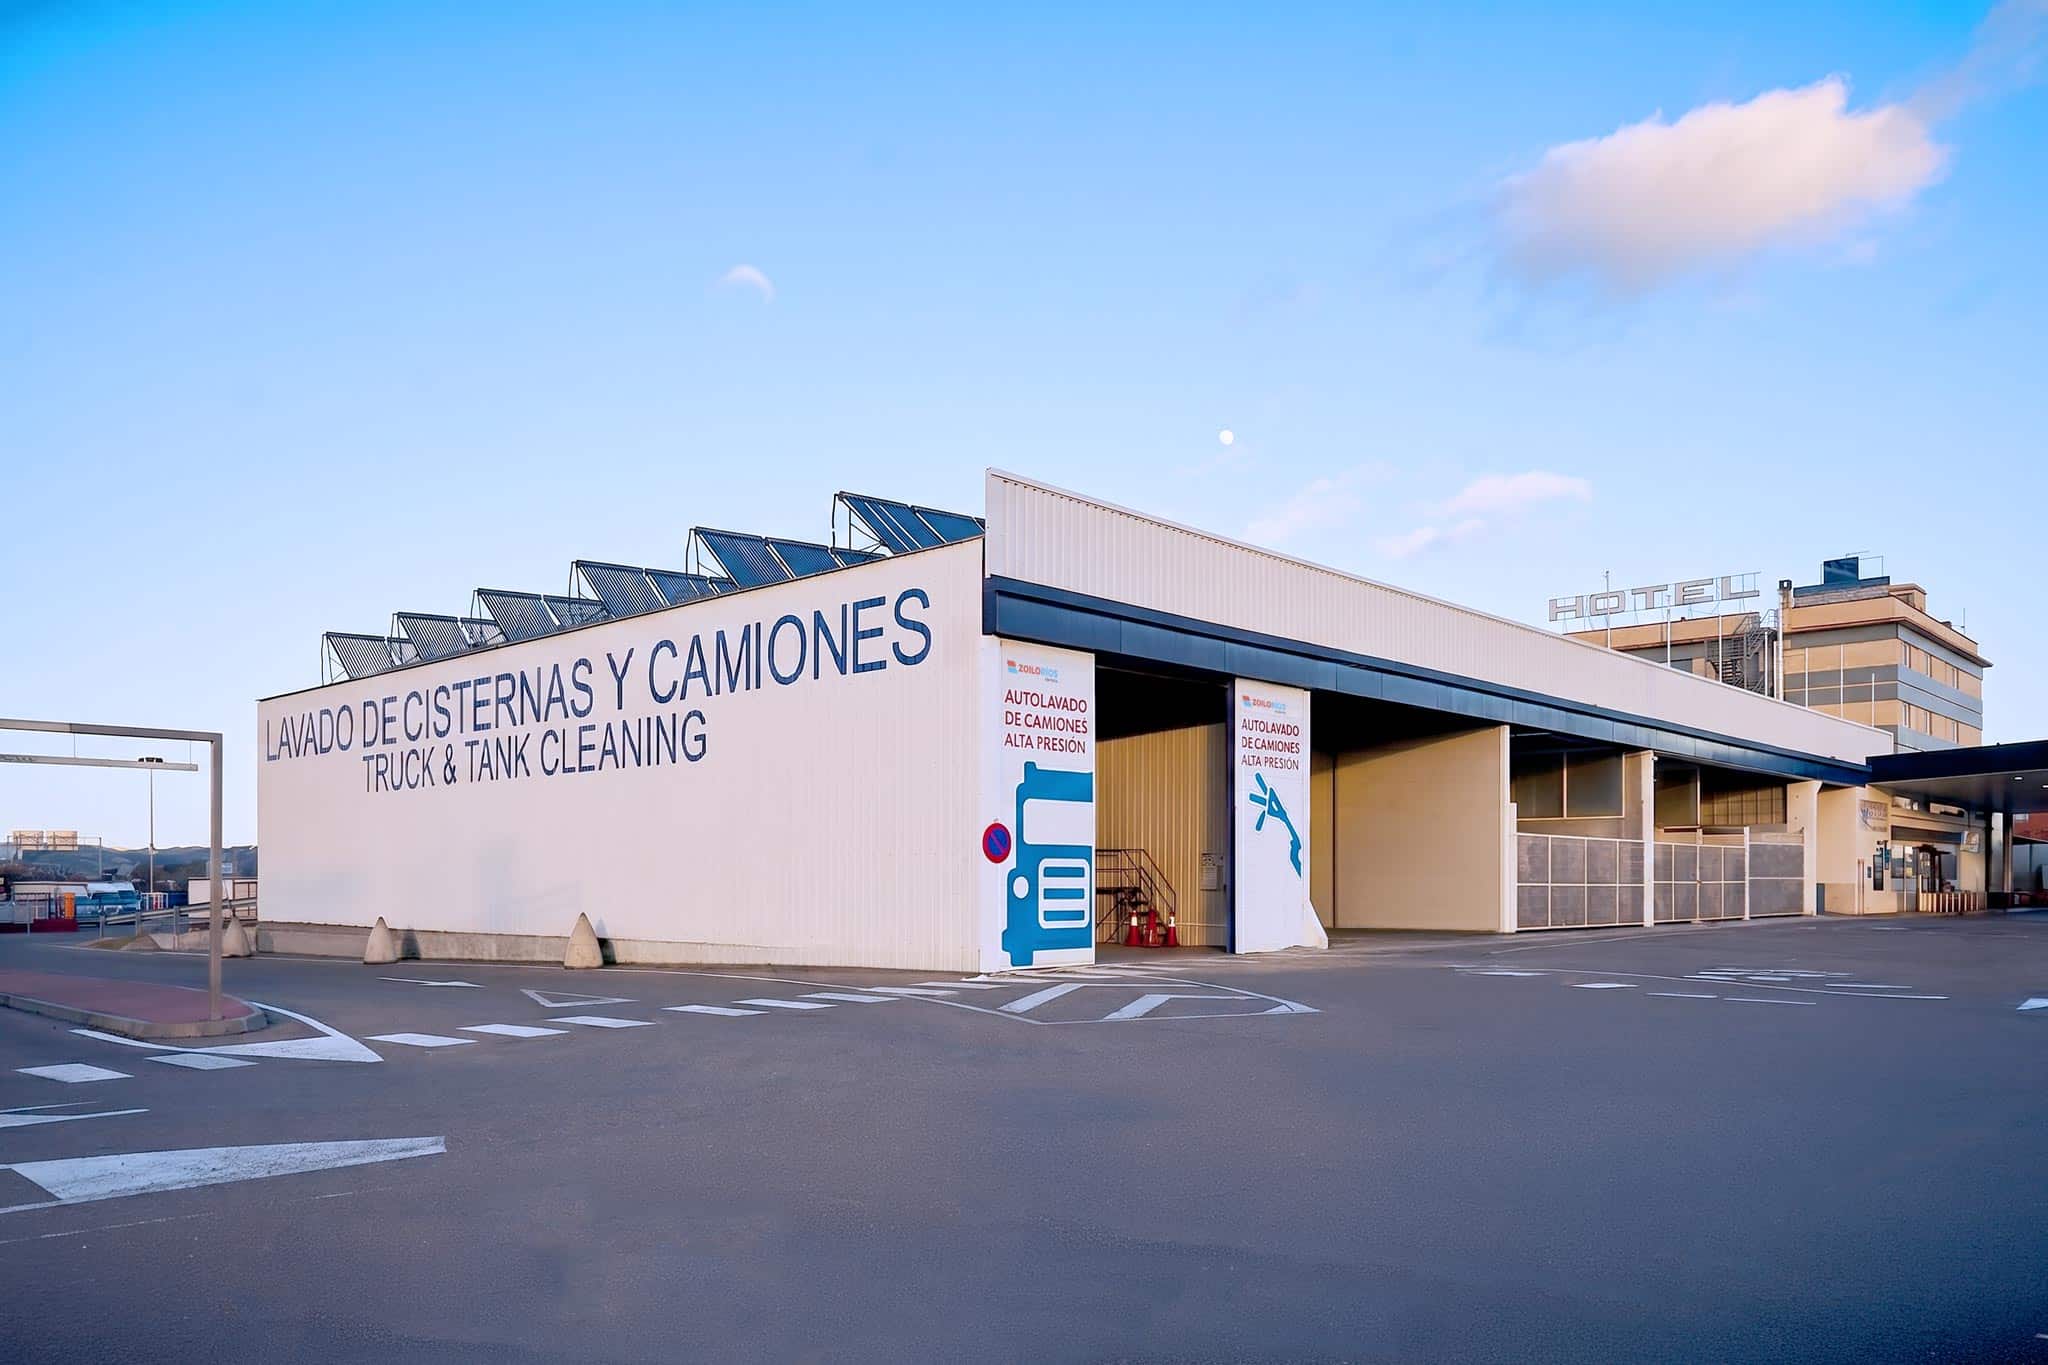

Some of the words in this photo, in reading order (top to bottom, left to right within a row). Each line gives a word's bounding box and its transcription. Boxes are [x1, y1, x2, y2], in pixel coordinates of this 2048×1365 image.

[1549, 576, 1760, 621] HOTEL
[266, 704, 354, 761] LAVADO
[363, 696, 398, 748] DE
[403, 658, 594, 742] CISTERNAS
[607, 647, 634, 710] Y
[648, 588, 932, 704] CAMIONES
[1004, 689, 1088, 713] AUTOLAVADO
[1005, 711, 1022, 726] DE
[1024, 713, 1088, 734] CAMIONES
[1241, 718, 1300, 737] AUTOLAVADO
[362, 747, 435, 793] TRUCK
[442, 743, 457, 785] &
[465, 733, 531, 782] TANK
[540, 709, 708, 776] CLEANING
[1004, 733, 1034, 749] ALTA
[1037, 736, 1086, 754] PRESIÓN
[1241, 736, 1253, 749] DE
[1254, 738, 1300, 754] CAMIONES
[1241, 754, 1262, 767] ALTA
[1264, 756, 1299, 771] PRESIÓN
